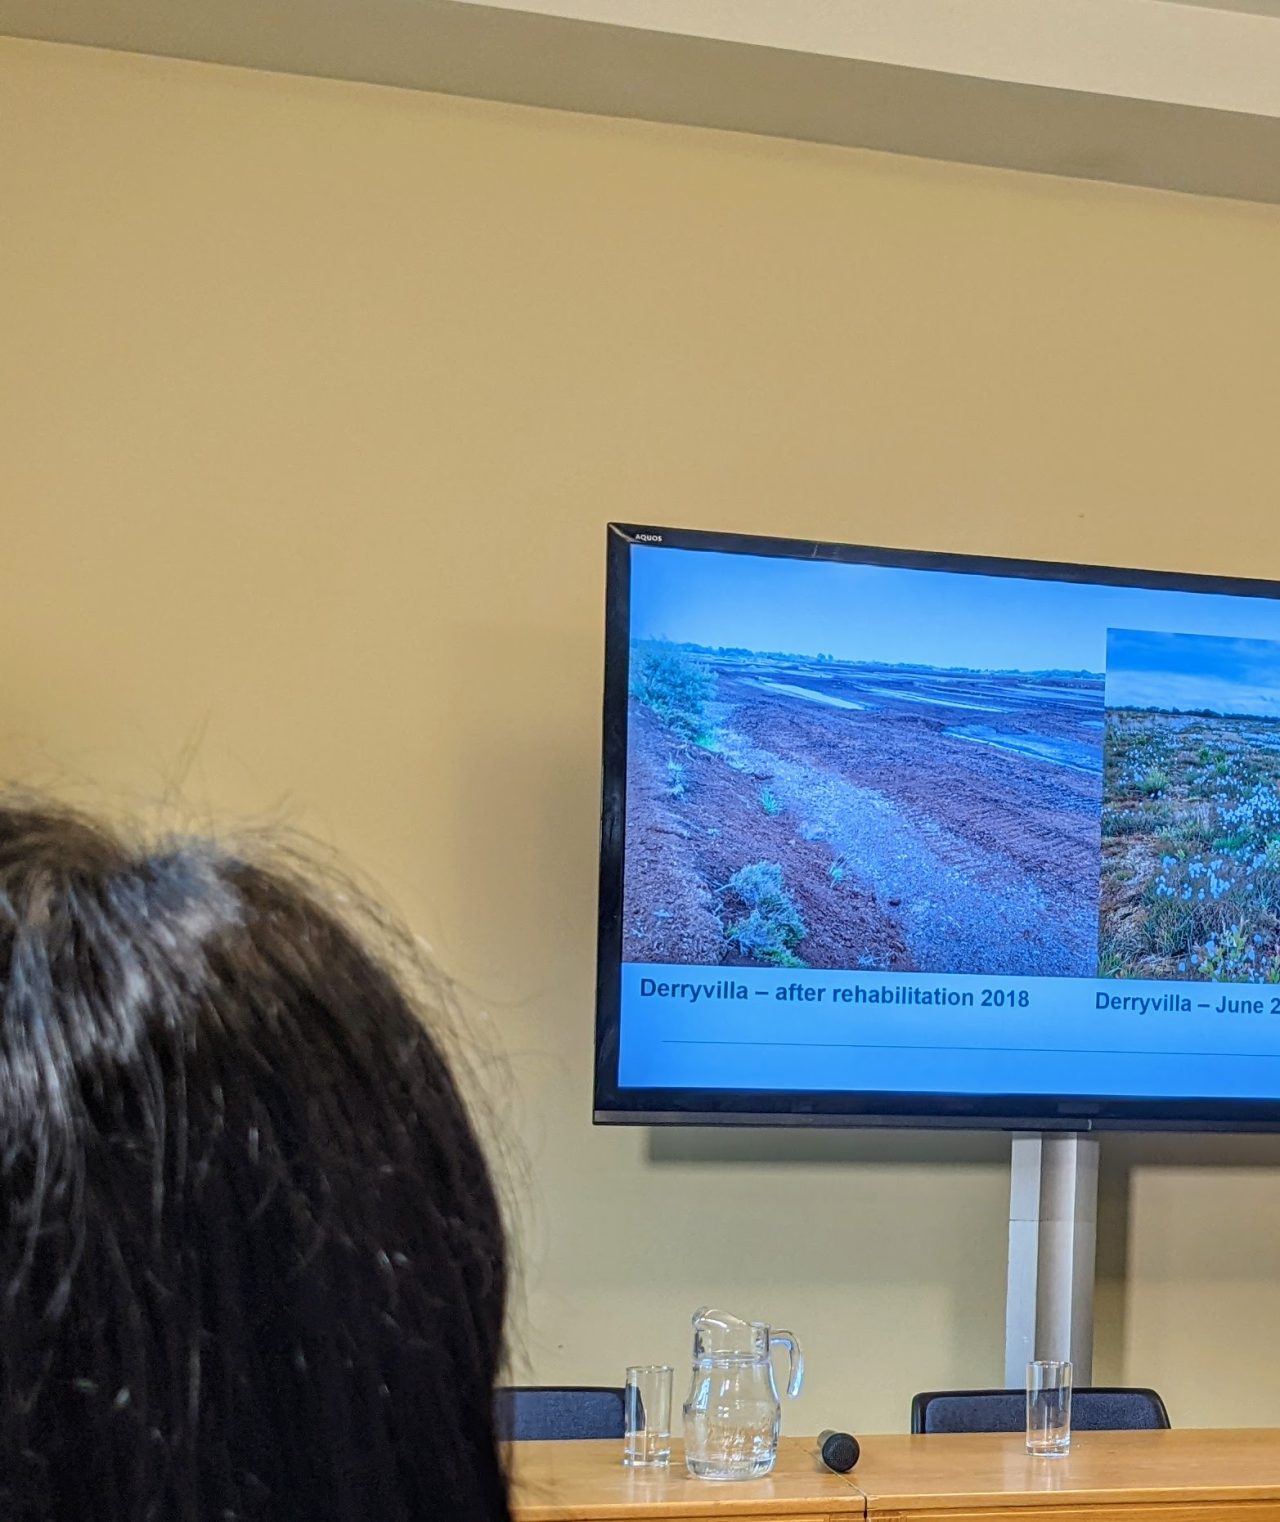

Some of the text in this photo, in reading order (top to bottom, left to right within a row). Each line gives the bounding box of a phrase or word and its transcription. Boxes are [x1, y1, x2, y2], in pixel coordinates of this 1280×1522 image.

[640, 978, 748, 1003] Derryvilla
[775, 984, 826, 1002] after
[832, 987, 974, 1006] rehabilitation
[980, 989, 1030, 1008] 2018
[1095, 991, 1192, 1015] Derryvilla
[1215, 996, 1264, 1014] June
